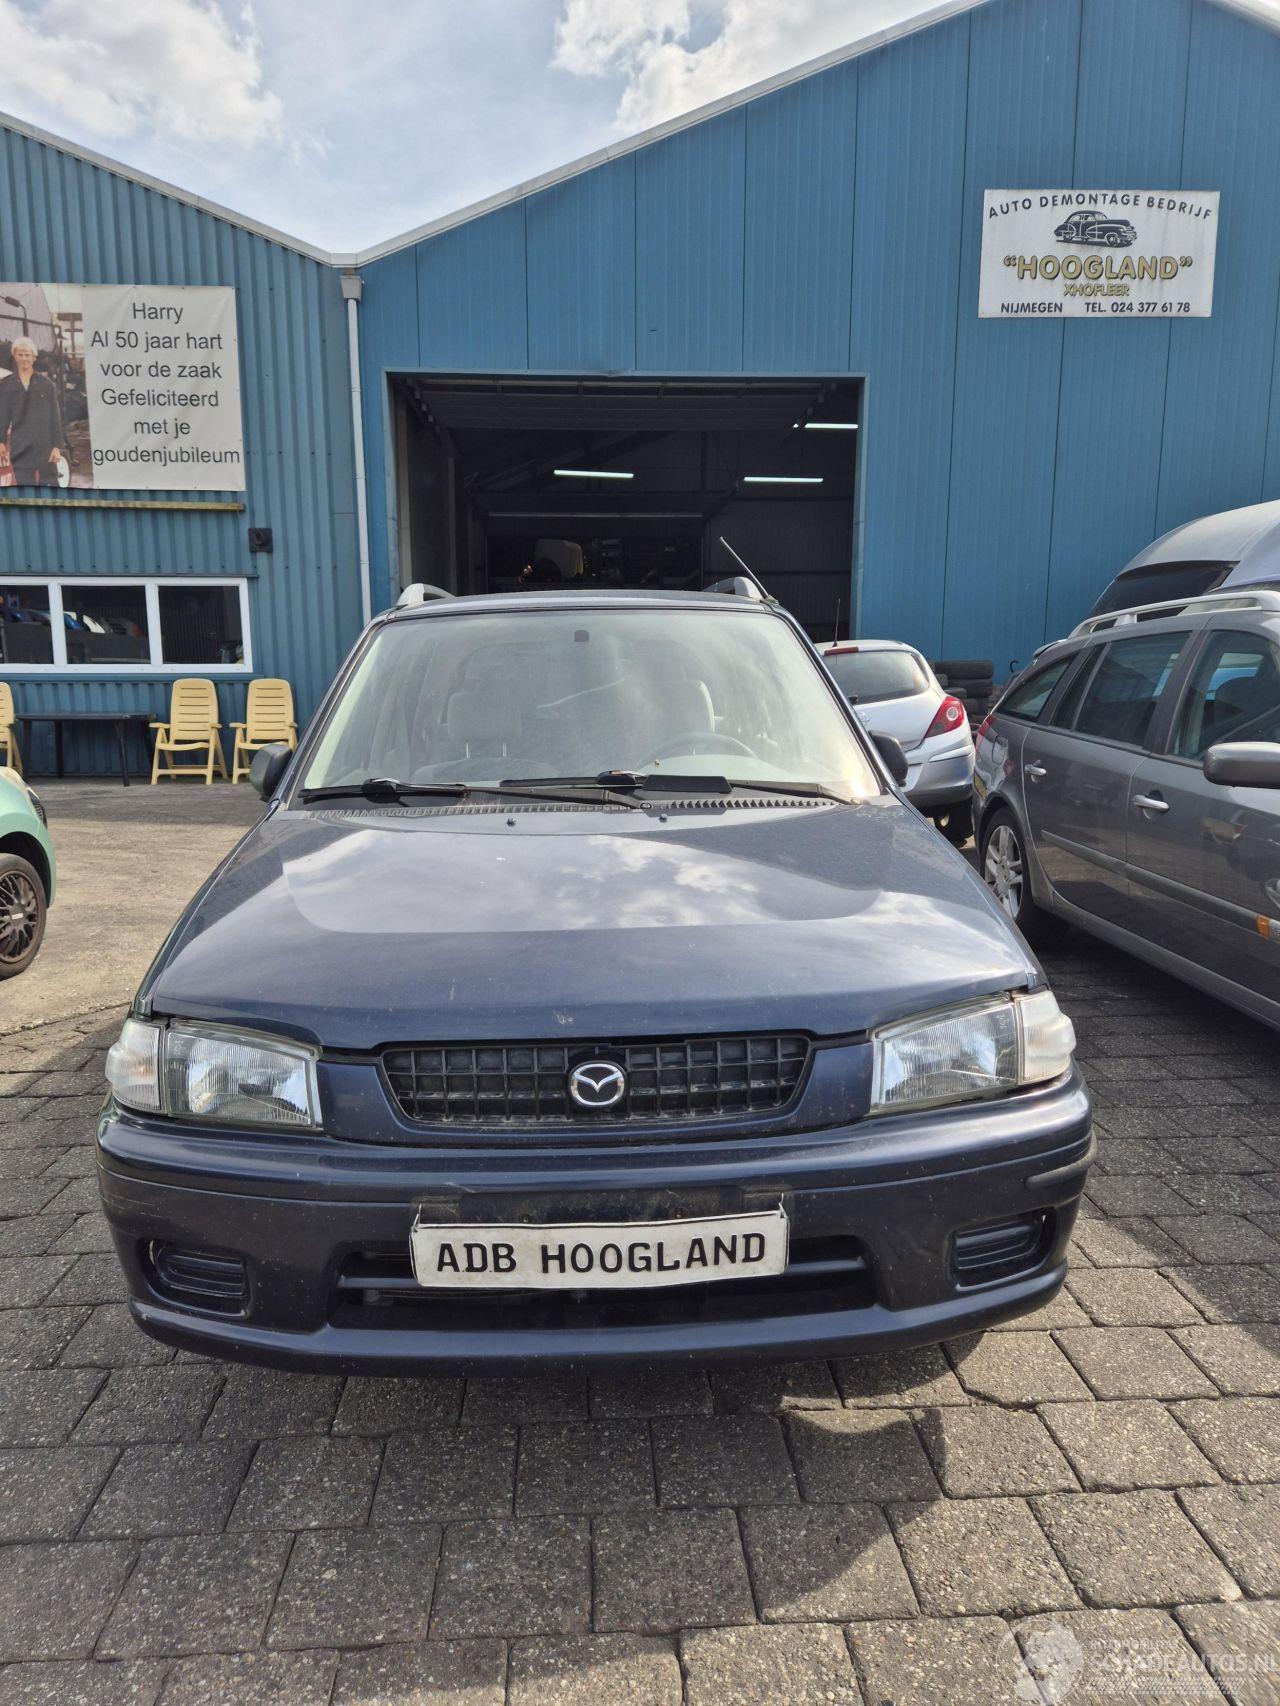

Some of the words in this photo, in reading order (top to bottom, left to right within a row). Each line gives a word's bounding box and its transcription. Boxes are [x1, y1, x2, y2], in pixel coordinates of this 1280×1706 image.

[988, 198, 1033, 219] AUTO
[1039, 193, 1141, 208] DEMONTAGE
[1146, 196, 1212, 220] BEDRIJF
[1063, 282, 1130, 297] XHOFLEER
[132, 302, 184, 324] Harry
[1000, 302, 1063, 313] NIJMEGEN
[1085, 302, 1107, 313] TEL.
[1111, 302, 1134, 313] 024
[1138, 302, 1157, 313] 377
[1161, 302, 1173, 313] 61
[1177, 302, 1191, 313] 78
[90, 331, 109, 348] Al
[115, 331, 139, 348] 50
[144, 332, 180, 353] jaar
[186, 332, 223, 350] hart
[100, 363, 142, 378] voor
[148, 361, 171, 378] de
[177, 362, 222, 379] zaak
[101, 388, 219, 407] Gefeliciteerd
[134, 419, 169, 435] met
[173, 418, 191, 439] je
[92, 446, 241, 467] goudenjubileum
[541, 1232, 766, 1274] HOOGLAND
